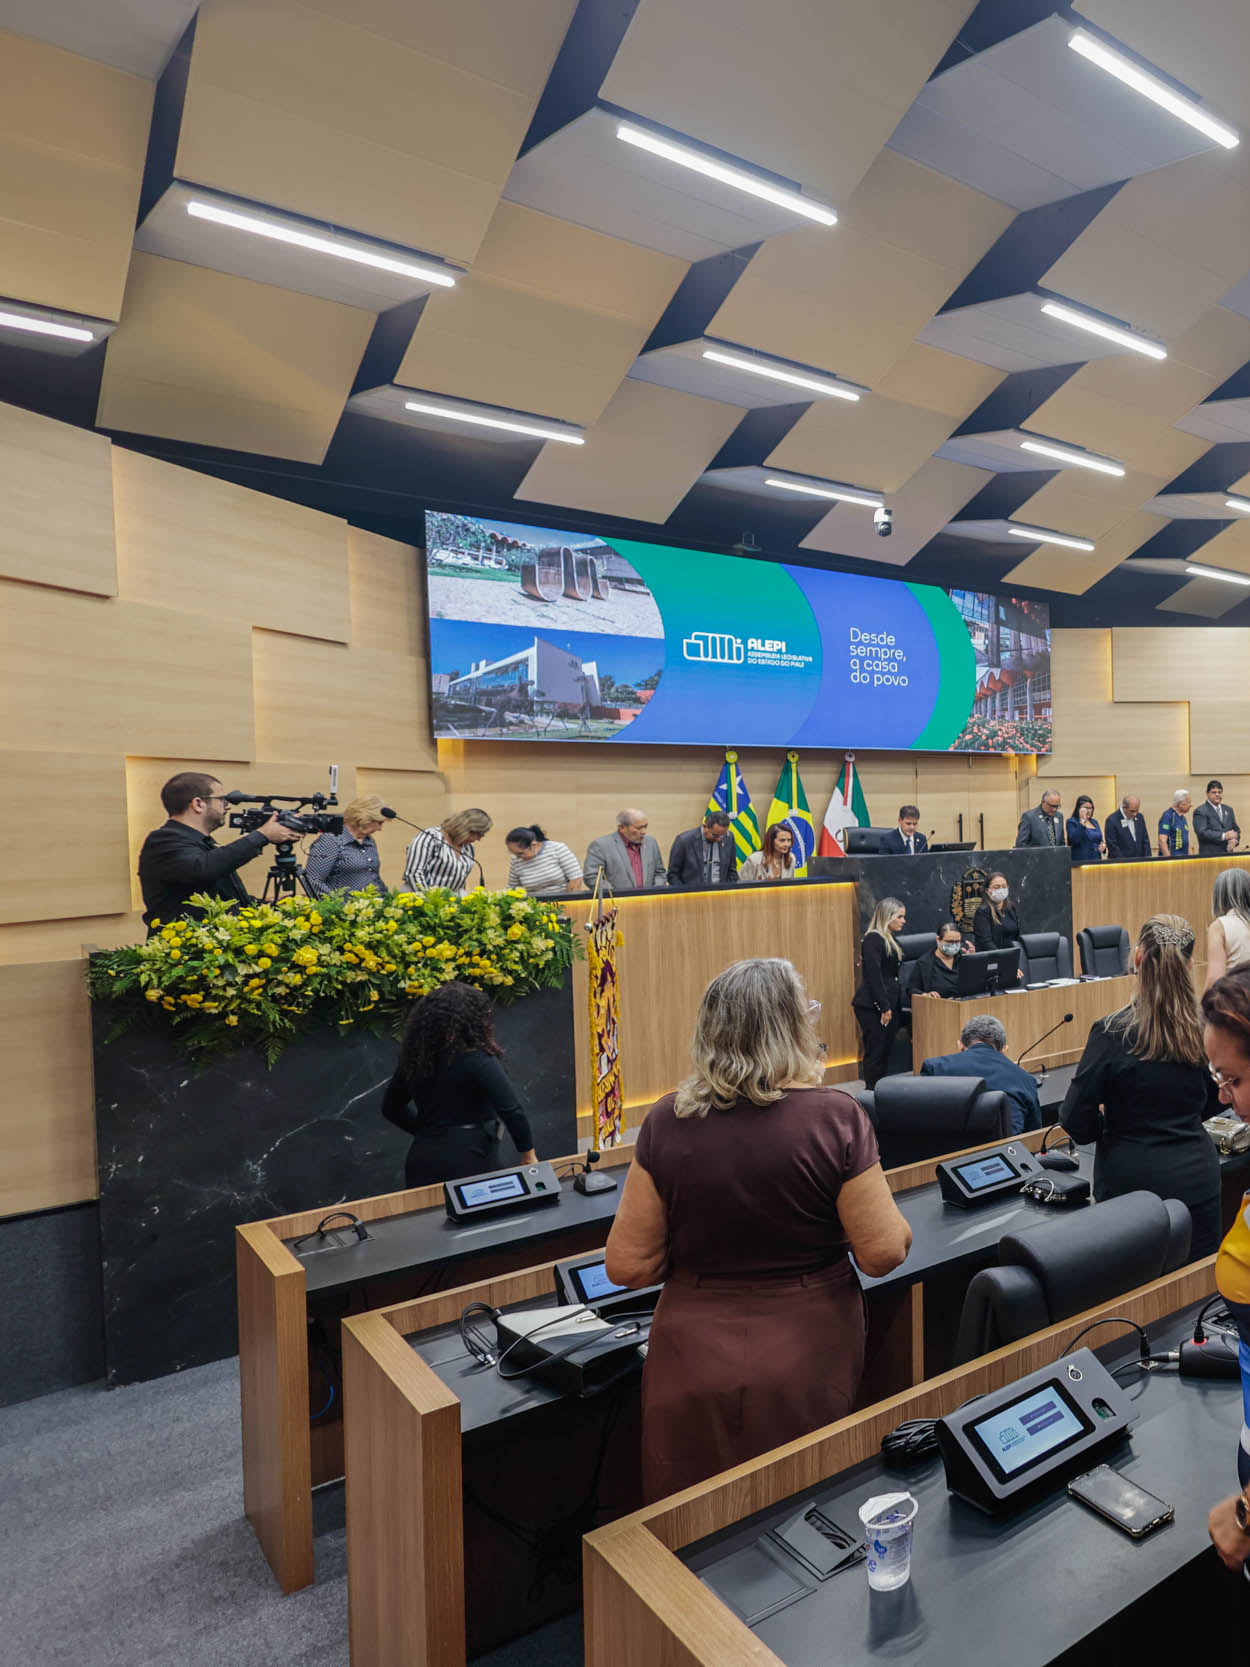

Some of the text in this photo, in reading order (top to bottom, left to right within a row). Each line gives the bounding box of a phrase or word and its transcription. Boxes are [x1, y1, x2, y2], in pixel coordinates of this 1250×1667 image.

[849, 627, 896, 646] Desde
[747, 638, 786, 653] ALEPI
[849, 645, 907, 662] sempre,
[758, 658, 780, 666] ESTADO
[850, 658, 898, 673] a casa
[850, 669, 909, 688] do povo
